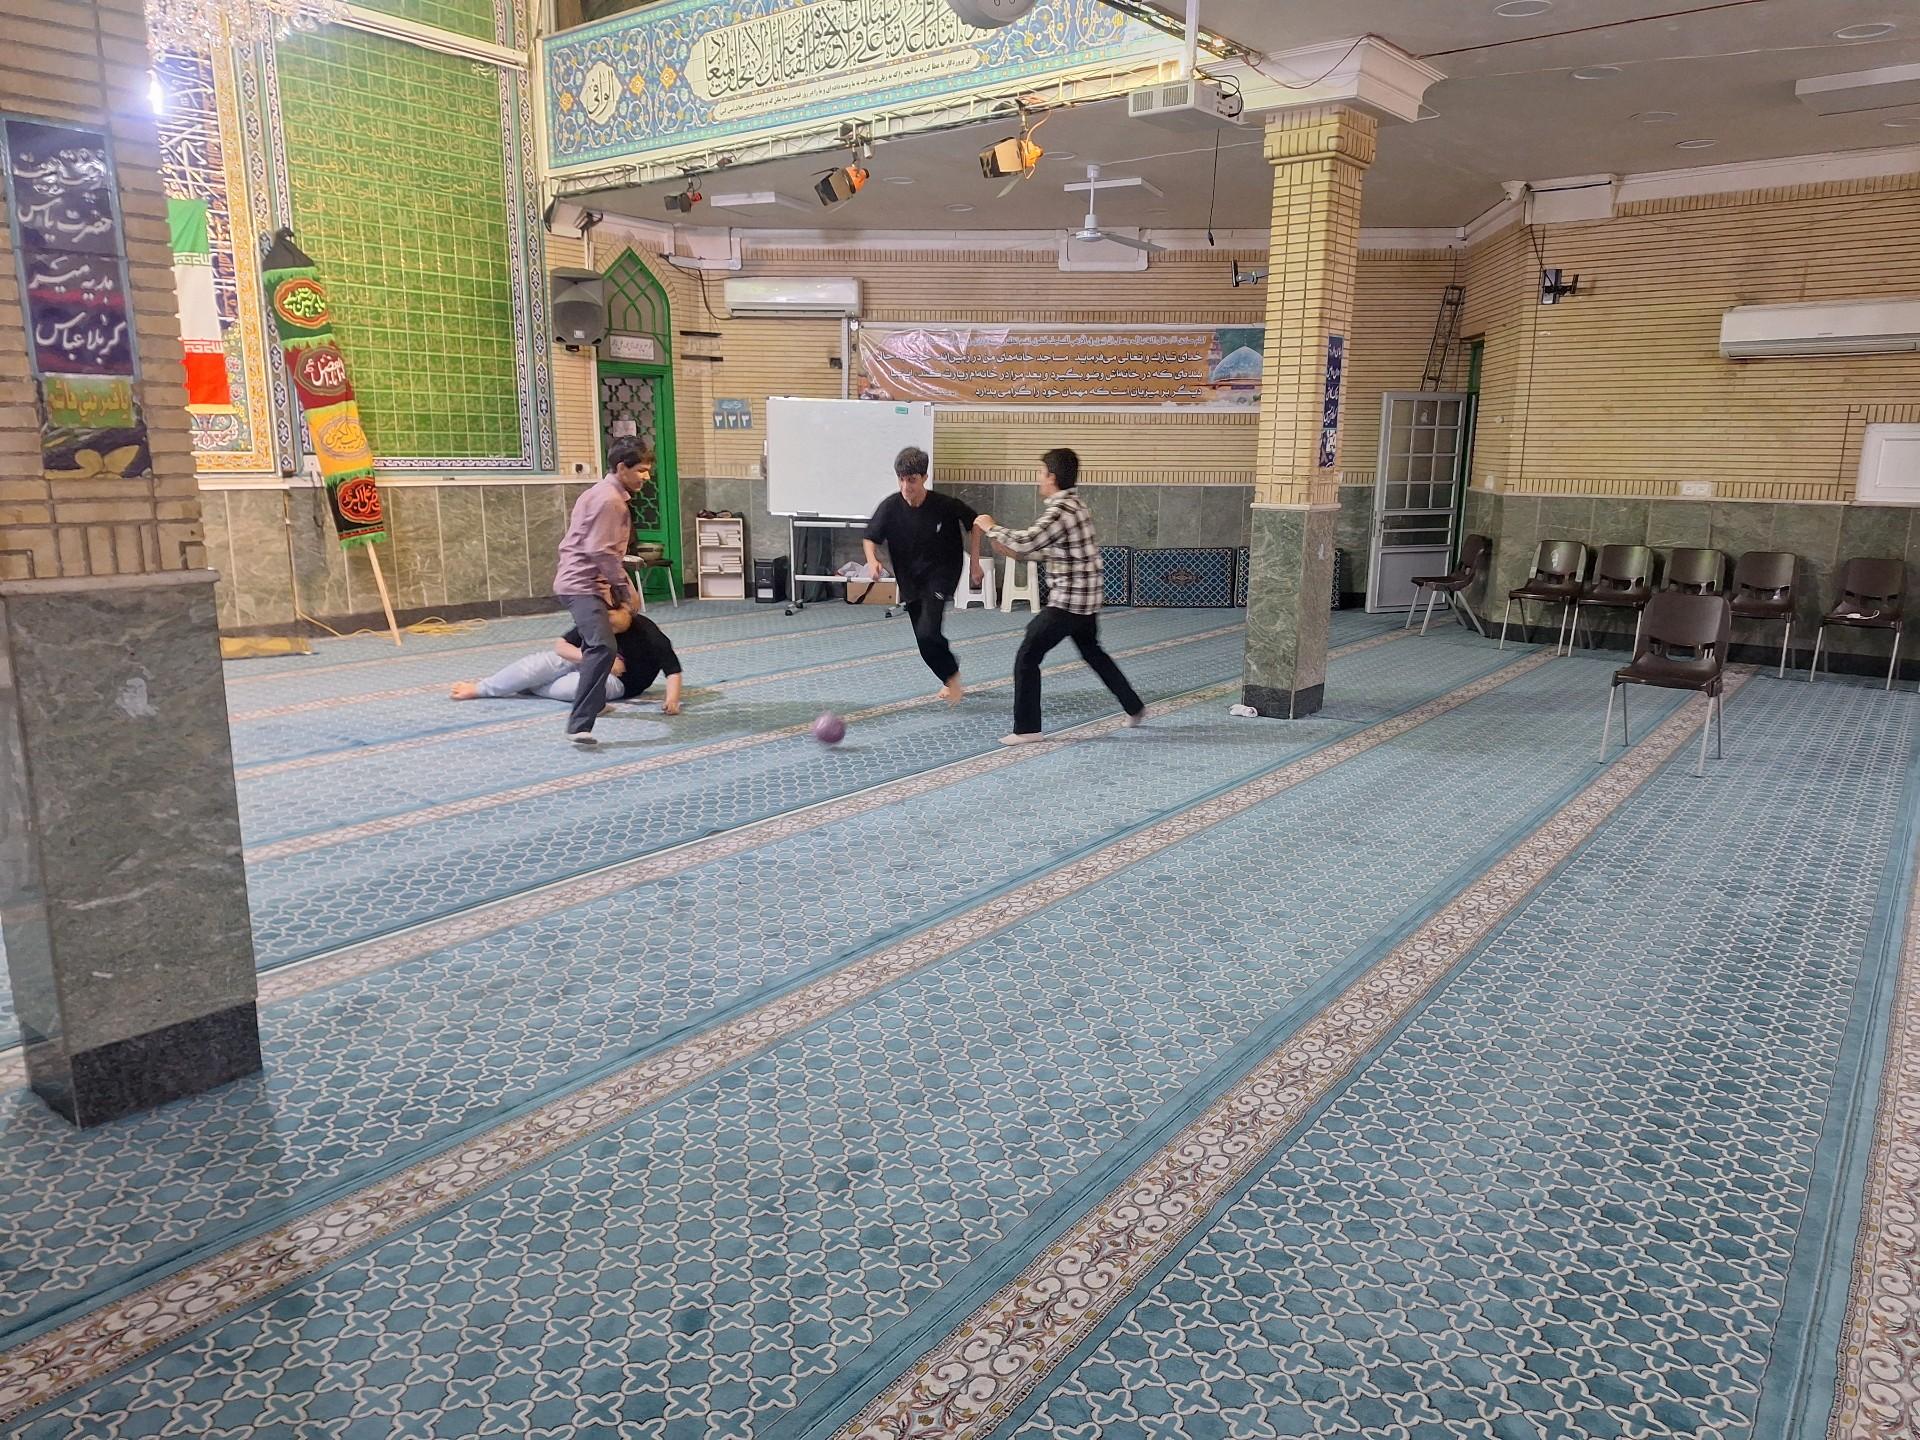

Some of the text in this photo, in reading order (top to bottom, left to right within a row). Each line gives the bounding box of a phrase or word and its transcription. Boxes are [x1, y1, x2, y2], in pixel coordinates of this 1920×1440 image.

[36, 311, 87, 361] عباس
[971, 355, 982, 364] در
[982, 354, 996, 364] من
[1036, 352, 1069, 364] مساجد
[1117, 351, 1144, 364] تعالی
[1144, 355, 1150, 364] و
[1151, 352, 1177, 364] تبارک
[1177, 351, 1203, 363] خدای
[942, 369, 969, 381] زیارت
[999, 372, 1010, 381] در
[1009, 370, 1024, 381] مرا
[1025, 371, 1042, 381] بعد
[1043, 373, 1049, 381] و
[1050, 367, 1083, 381] بگیرد
[1083, 371, 1105, 381] وضو
[1140, 371, 1151, 381] در
[1151, 369, 1173, 379] که
[975, 386, 997, 398] بدارد
[997, 384, 1032, 398] گرامی
[1032, 387, 1040, 398] را
[1041, 386, 1060, 398] خود
[1060, 386, 1088, 398] مهمان
[1088, 386, 1110, 396] که
[1110, 387, 1130, 396] است
[1130, 386, 1160, 398] میزبان
[1160, 388, 1171, 398] بر
[1172, 384, 1202, 398] دیگر
